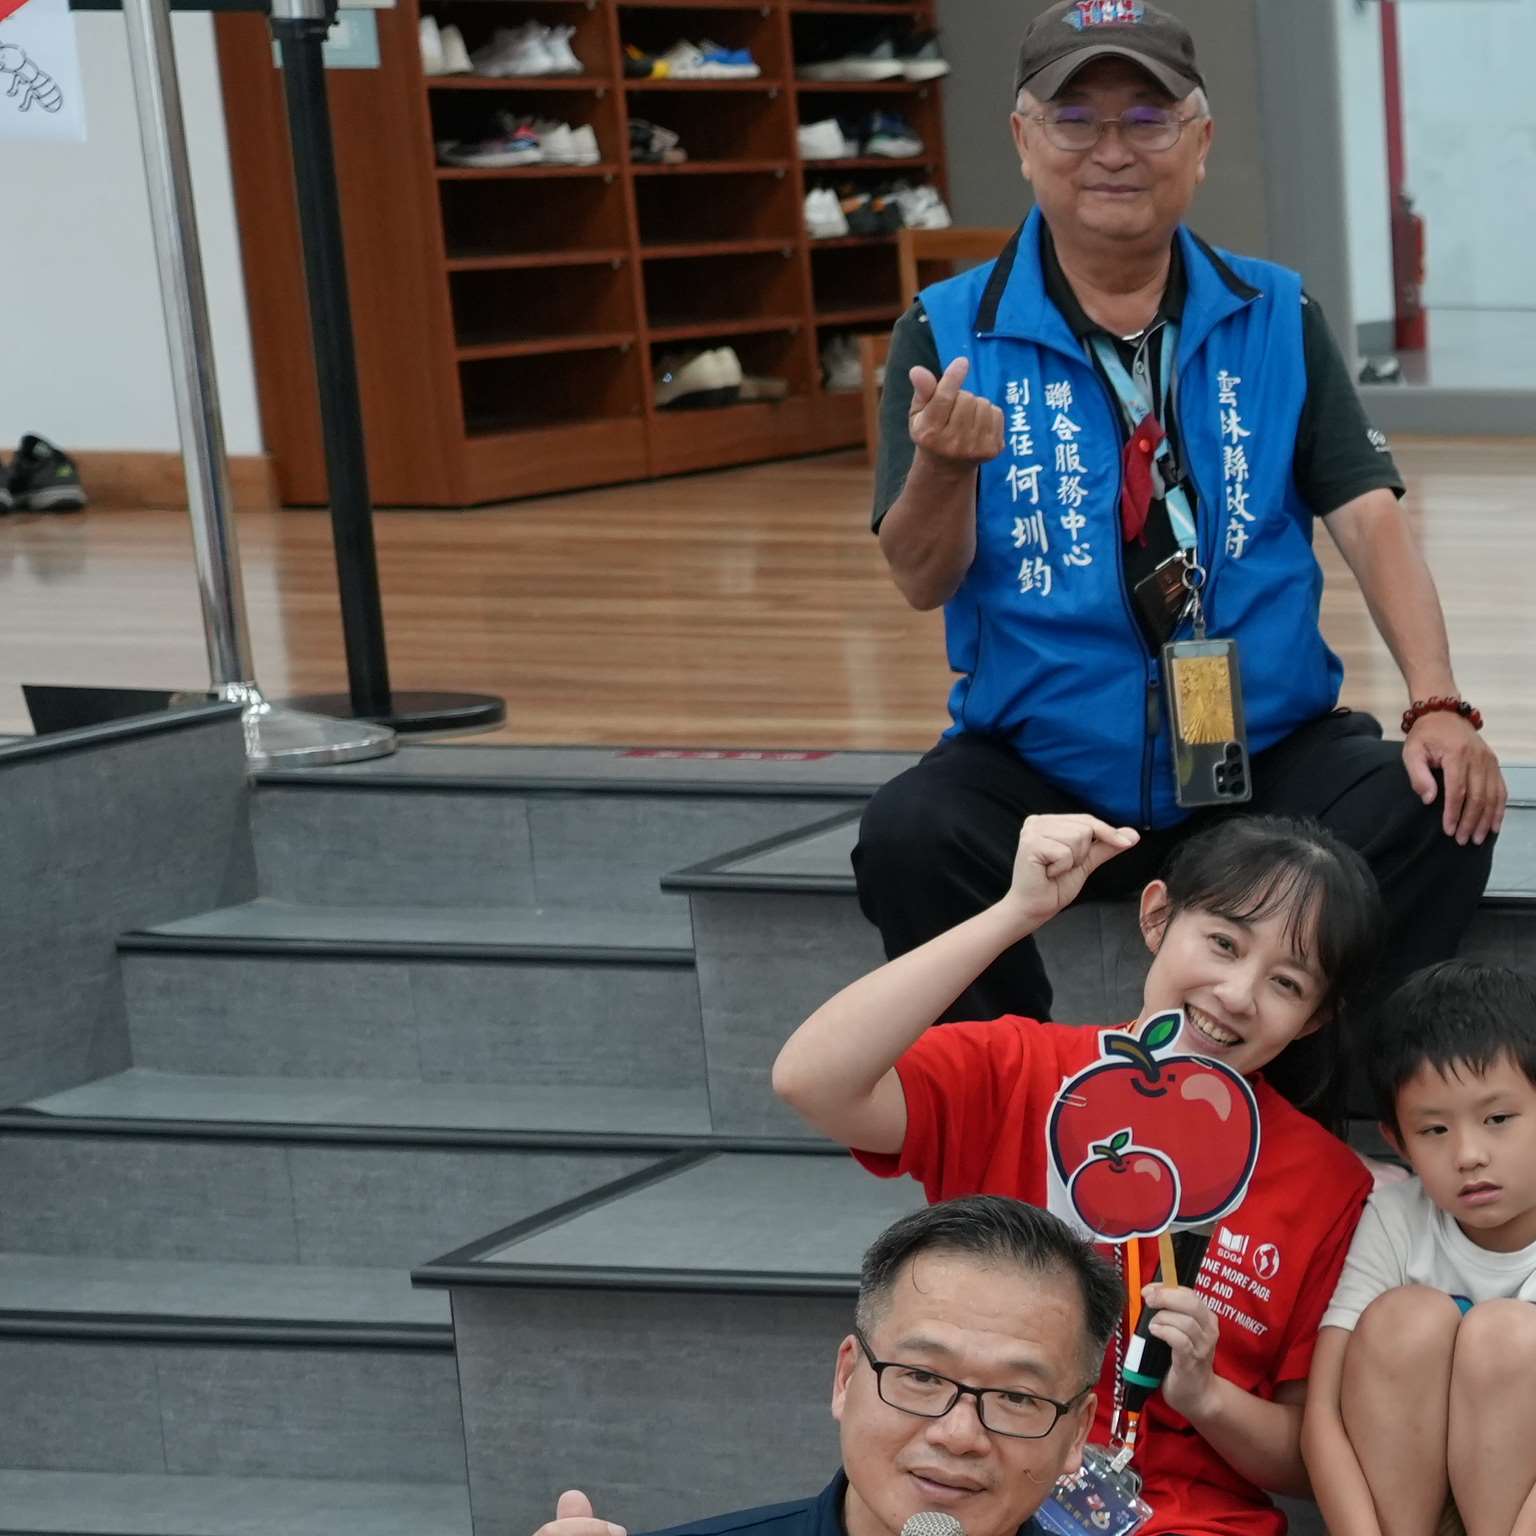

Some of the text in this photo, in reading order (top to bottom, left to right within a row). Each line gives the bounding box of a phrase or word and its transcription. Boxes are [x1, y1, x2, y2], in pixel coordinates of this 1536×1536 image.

[1044, 379, 1093, 568] 聯合服務中心
[1216, 369, 1257, 560] 雲林縣政府
[1221, 1265, 1250, 1289] MORE
[1211, 1281, 1234, 1299] AND
[1235, 1311, 1268, 1336] MARKET
